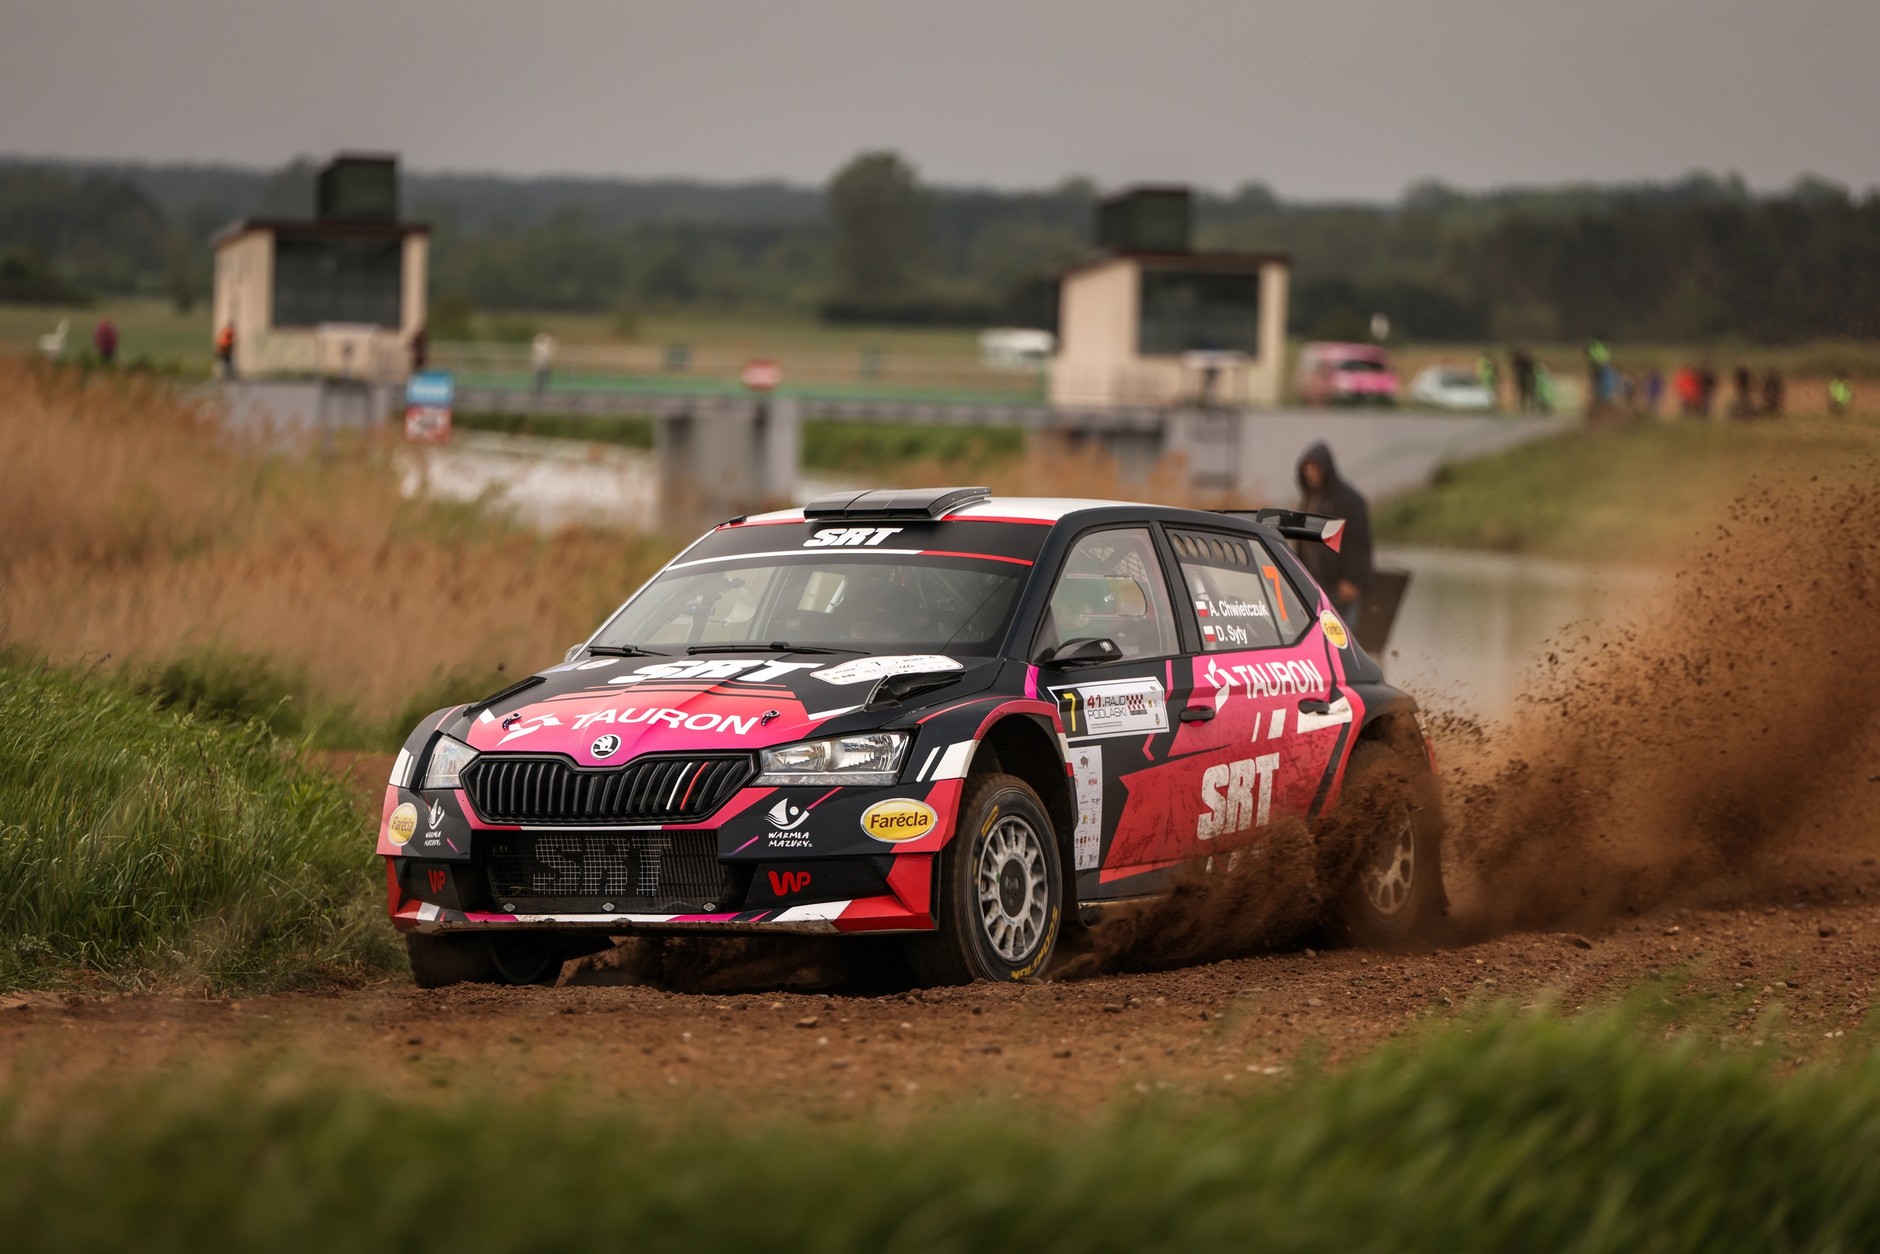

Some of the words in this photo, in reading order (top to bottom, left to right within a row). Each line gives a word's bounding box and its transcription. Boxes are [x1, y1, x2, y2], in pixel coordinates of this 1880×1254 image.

[803, 528, 904, 547] SRT
[1262, 565, 1288, 621] 7
[1209, 600, 1220, 616] A.
[1215, 625, 1228, 641] D.
[608, 660, 825, 684] SRT
[1231, 659, 1324, 699] TAURON
[570, 707, 759, 735] TAURON
[1063, 693, 1076, 731] 7
[1088, 707, 1127, 720] PODLASKI
[1197, 752, 1280, 840] SRT
[870, 812, 928, 829] Farécla
[768, 831, 810, 840] WARMIA
[533, 836, 672, 896] SRT
[768, 870, 812, 897] WP
